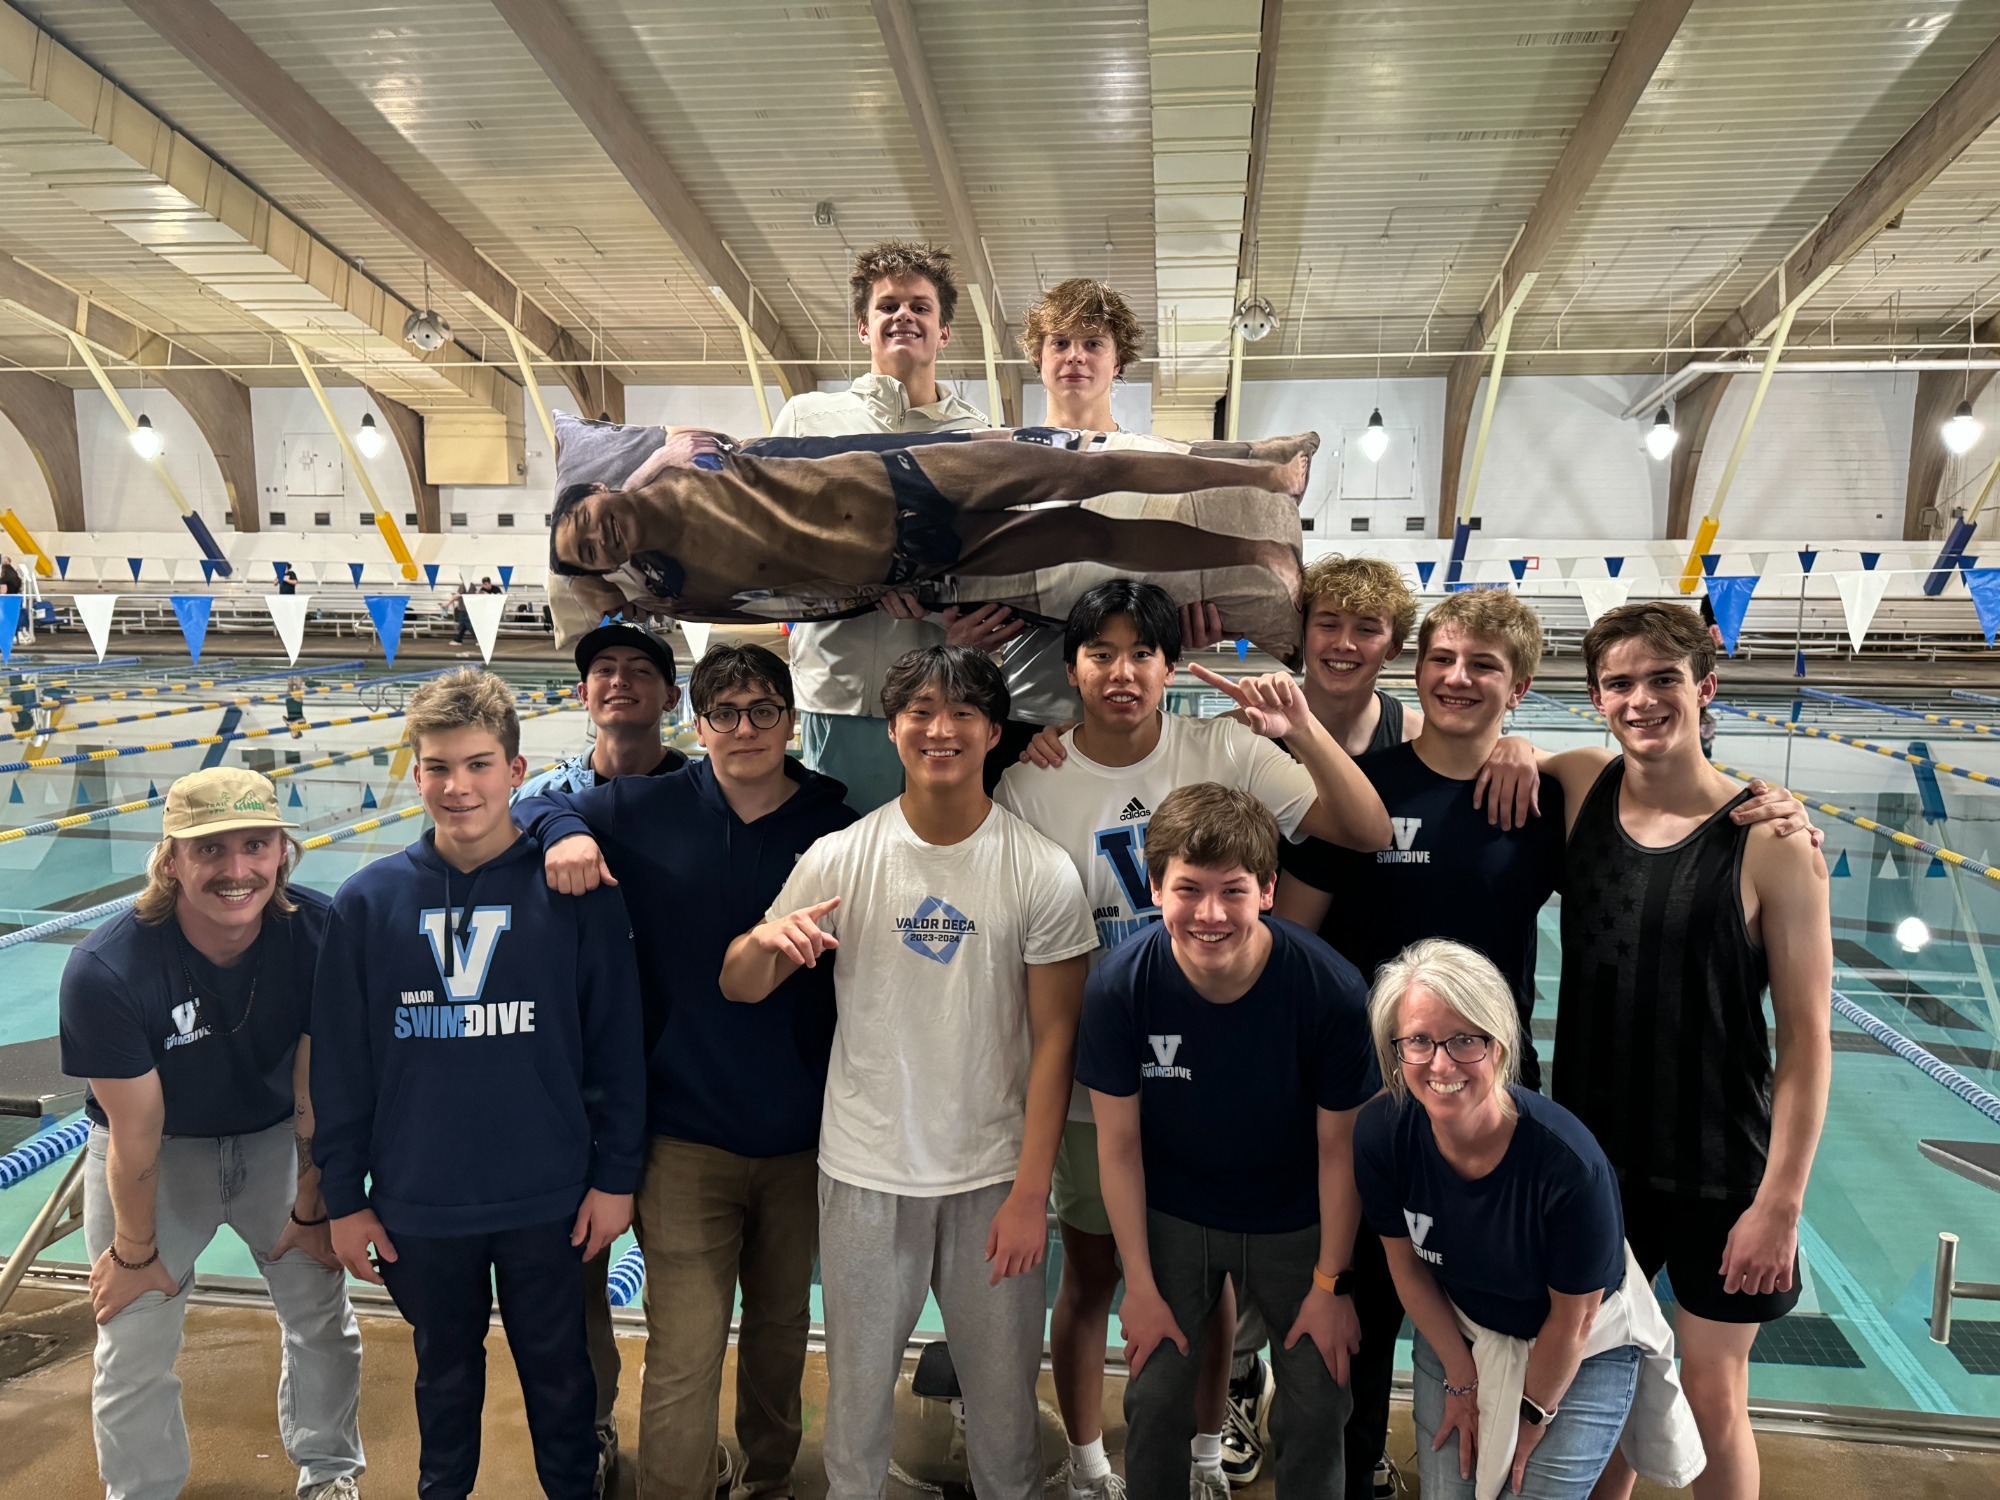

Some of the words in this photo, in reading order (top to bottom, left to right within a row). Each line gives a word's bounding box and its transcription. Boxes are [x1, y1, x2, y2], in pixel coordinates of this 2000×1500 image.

[1119, 809, 1151, 821] adidas
[1391, 817, 1422, 850] V
[896, 918, 939, 930] VALOR
[942, 919, 976, 932] DECA
[1093, 906, 1120, 922] VALOR
[910, 934, 960, 943] 2023-2024
[419, 905, 512, 1001] V
[401, 990, 435, 1005] VALOR
[171, 997, 201, 1036] V
[1147, 1034, 1183, 1067] V
[1403, 1207, 1434, 1247] V
